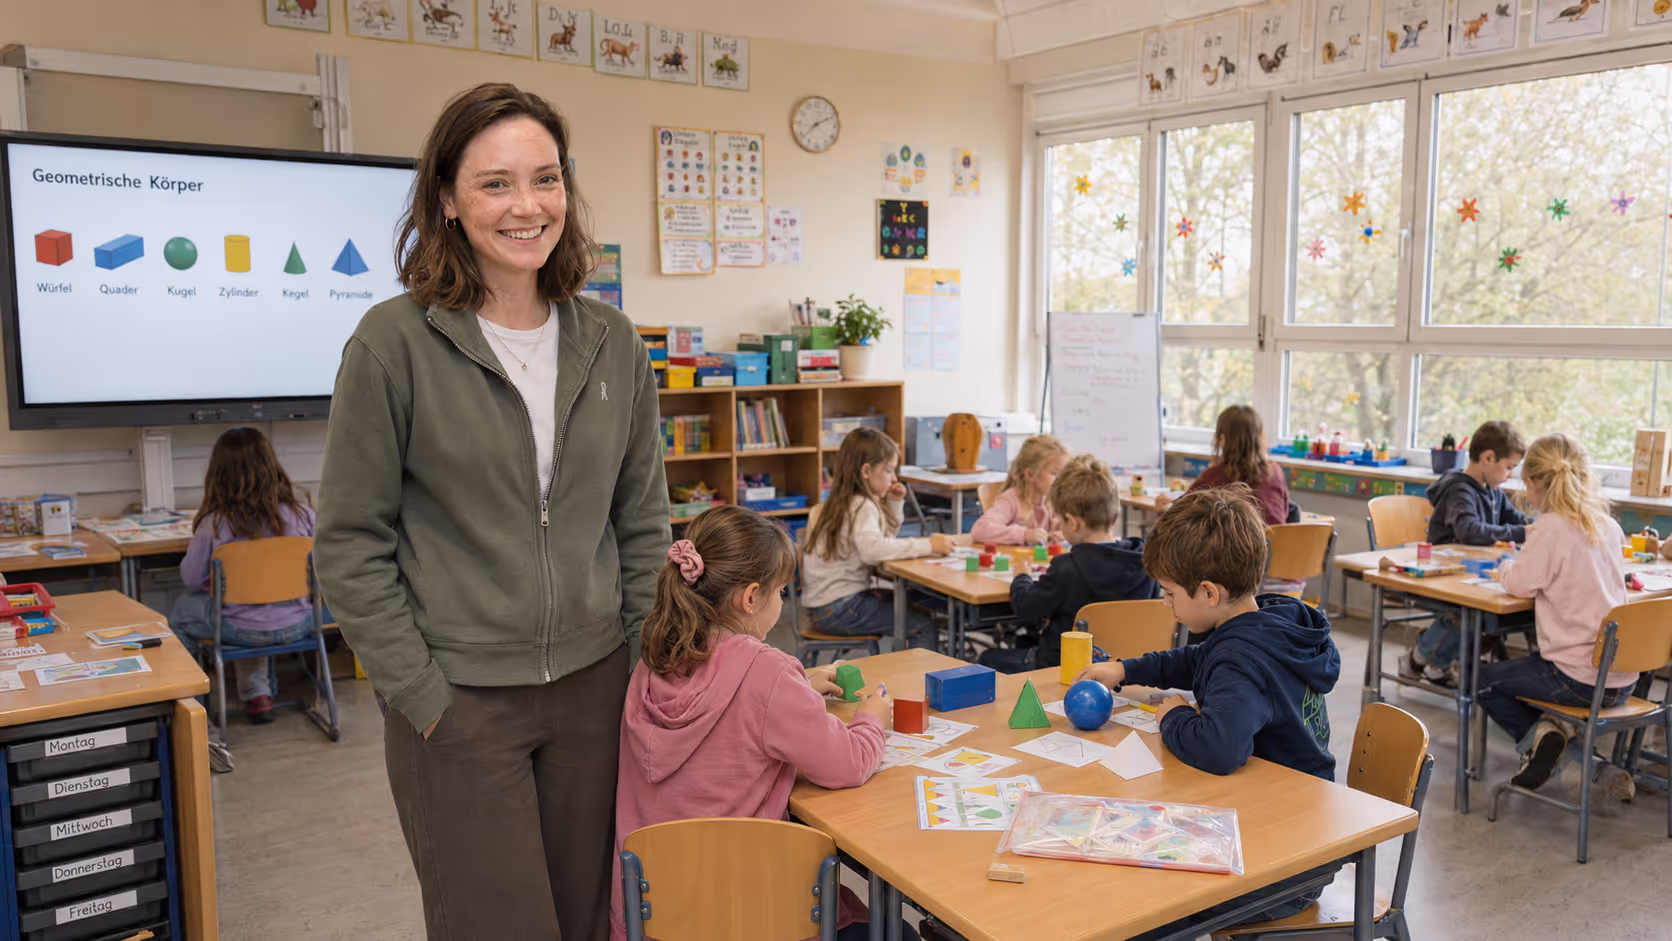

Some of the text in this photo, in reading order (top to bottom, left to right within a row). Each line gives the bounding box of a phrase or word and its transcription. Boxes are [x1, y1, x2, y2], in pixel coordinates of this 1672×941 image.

[31, 167, 205, 195] Geometrische Körper
[36, 282, 73, 294] Würfel
[99, 283, 138, 296] Quader
[167, 285, 197, 299] Kugel
[218, 286, 259, 299] Zylinder
[282, 288, 309, 301] Kegel
[329, 288, 374, 301] Pyramide
[49, 737, 96, 753] Montag
[54, 777, 109, 795] Dienstag
[56, 815, 113, 837] Mittwoch
[54, 857, 122, 879] Donnerstag
[69, 901, 113, 919] Freitag
